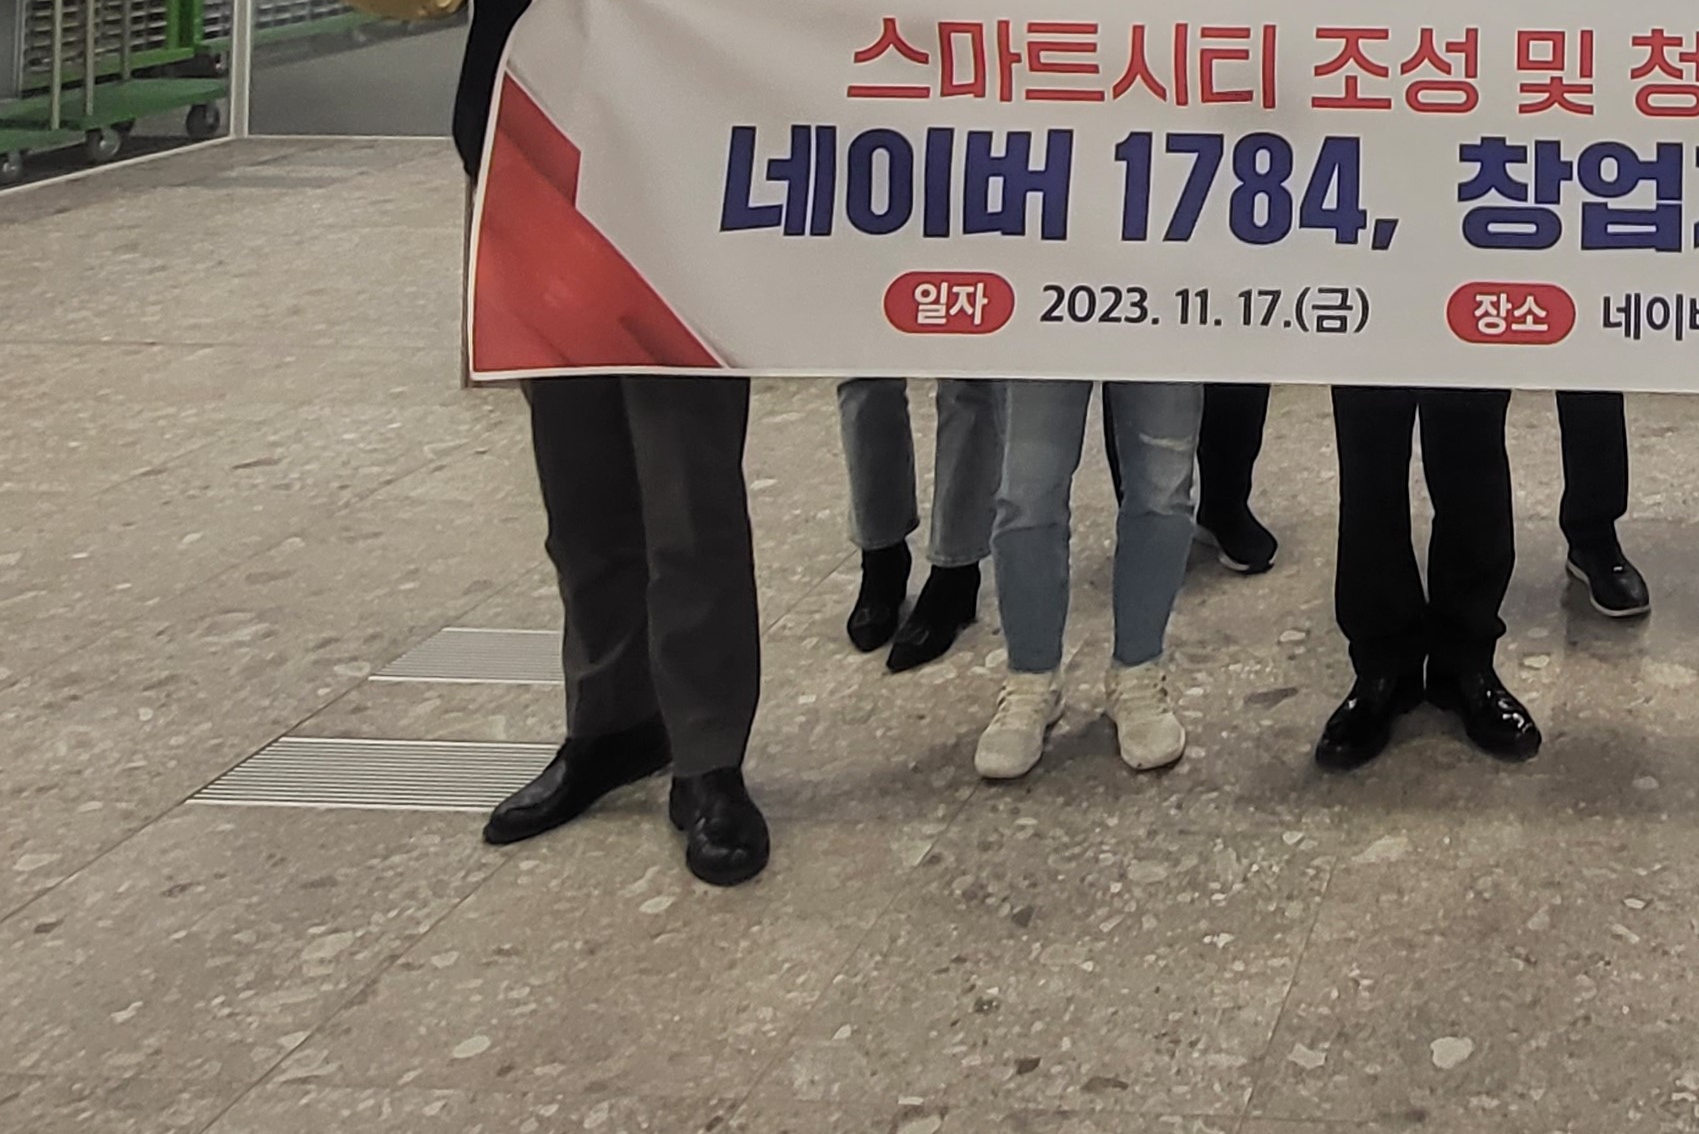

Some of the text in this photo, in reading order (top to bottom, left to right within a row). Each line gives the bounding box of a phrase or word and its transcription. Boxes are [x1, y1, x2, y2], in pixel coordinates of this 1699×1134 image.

[847, 16, 1277, 110] 스마트시티
[1311, 26, 1479, 115] 조성
[1515, 29, 1595, 117] 및
[718, 123, 1075, 242] 네이버
[1113, 131, 1400, 252] 1784,
[913, 281, 988, 326] 일자
[1039, 284, 1160, 325] 2023.
[1175, 288, 1222, 327] 11.
[1474, 293, 1549, 335] 장소
